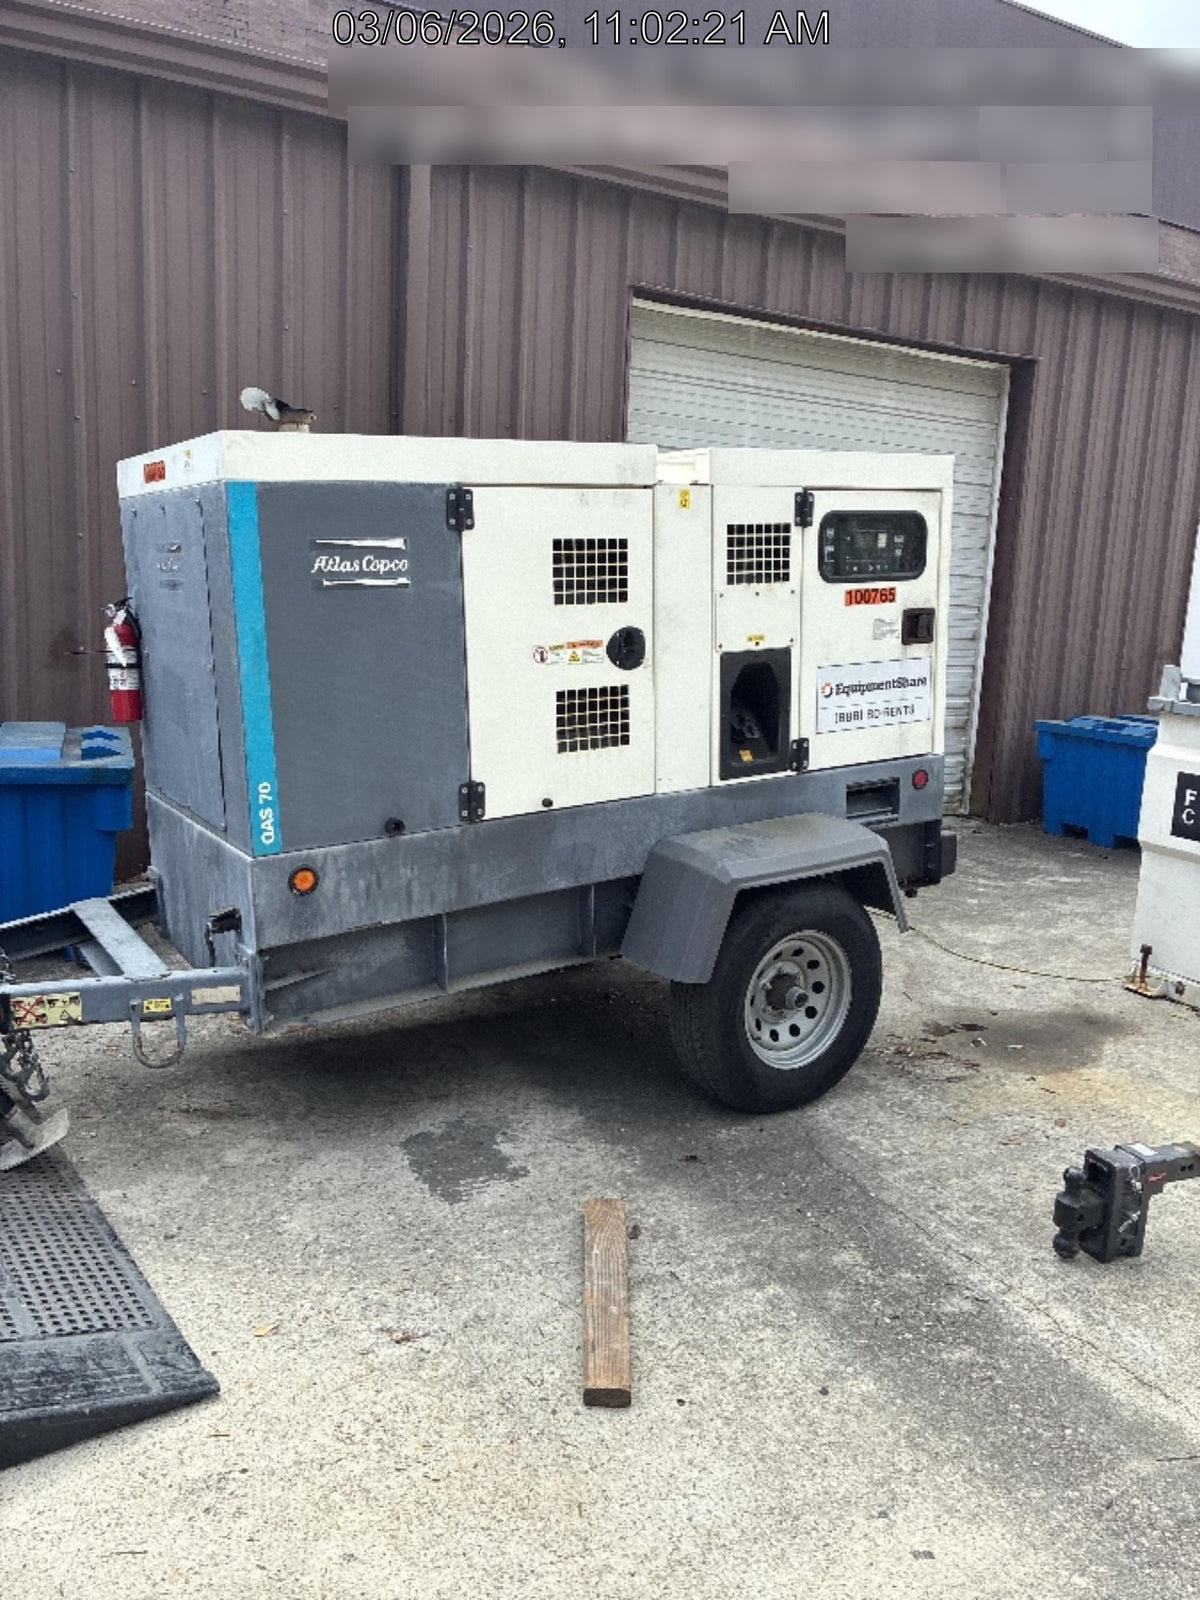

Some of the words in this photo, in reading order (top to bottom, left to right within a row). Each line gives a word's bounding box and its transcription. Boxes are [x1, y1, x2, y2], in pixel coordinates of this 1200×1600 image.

[310, 555, 360, 573] Atlas
[362, 554, 408, 575] Copco
[845, 587, 896, 605] 100765
[835, 677, 927, 696] EquipmentShare
[258, 781, 273, 805] 70
[260, 806, 275, 845] QAS
